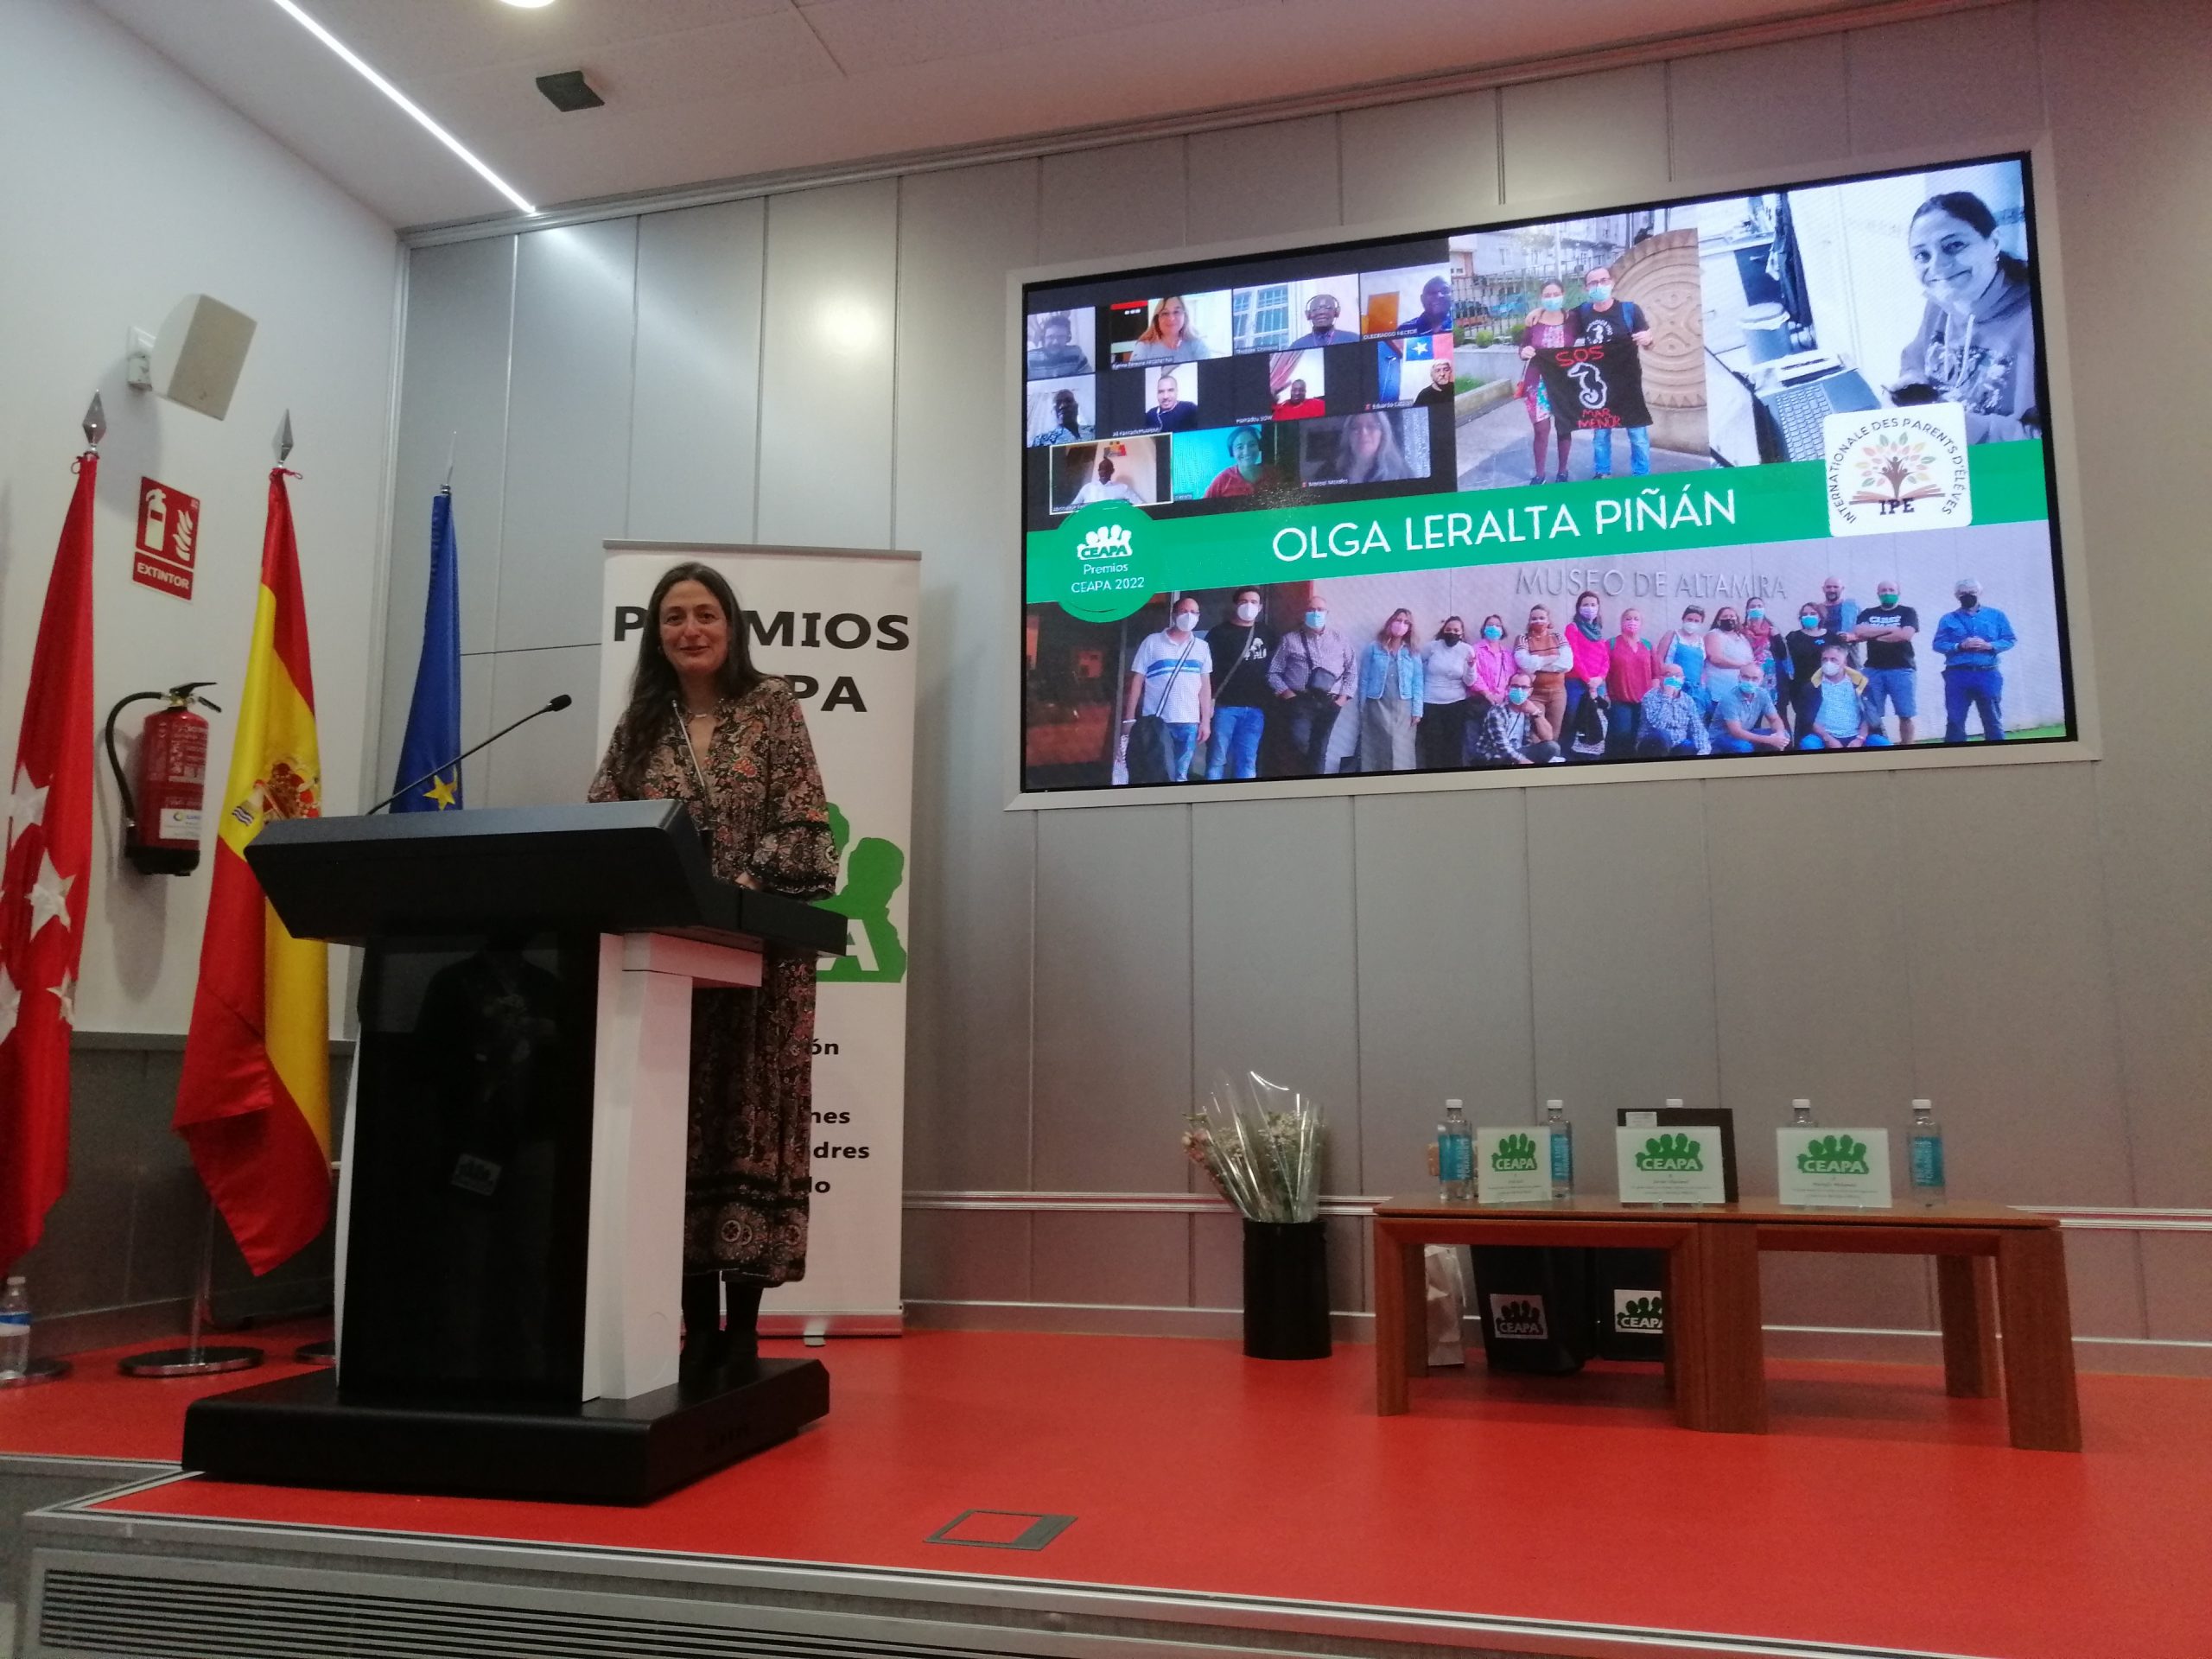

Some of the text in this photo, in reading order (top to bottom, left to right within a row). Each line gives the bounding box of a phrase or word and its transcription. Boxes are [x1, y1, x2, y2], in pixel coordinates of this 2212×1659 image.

[1555, 346, 1605, 367] SOS
[1582, 407, 1611, 418] MAR
[1577, 415, 1621, 429] MENOR
[1828, 426, 1870, 524] INTERNATIONALE
[1871, 417, 1899, 431] DES
[1902, 418, 1958, 454] PARENTS
[1878, 498, 1915, 516] IPE
[1272, 483, 1737, 563] OLGA LERALTA PIÑÁN
[1081, 545, 1128, 558] CEAPA
[137, 562, 190, 589] EXTINTOR
[1084, 563, 1129, 575] Premios
[1071, 577, 1145, 593] CEAPA 2022
[1515, 568, 1789, 600] MUSEO DE ALTAMIRA
[613, 606, 910, 651] PMIOS
[1496, 1158, 1535, 1171] CEAPA
[1642, 1158, 1699, 1170] CEAPA
[1803, 1160, 1865, 1173] CEAPA
[1499, 1321, 1540, 1334] CEAPA
